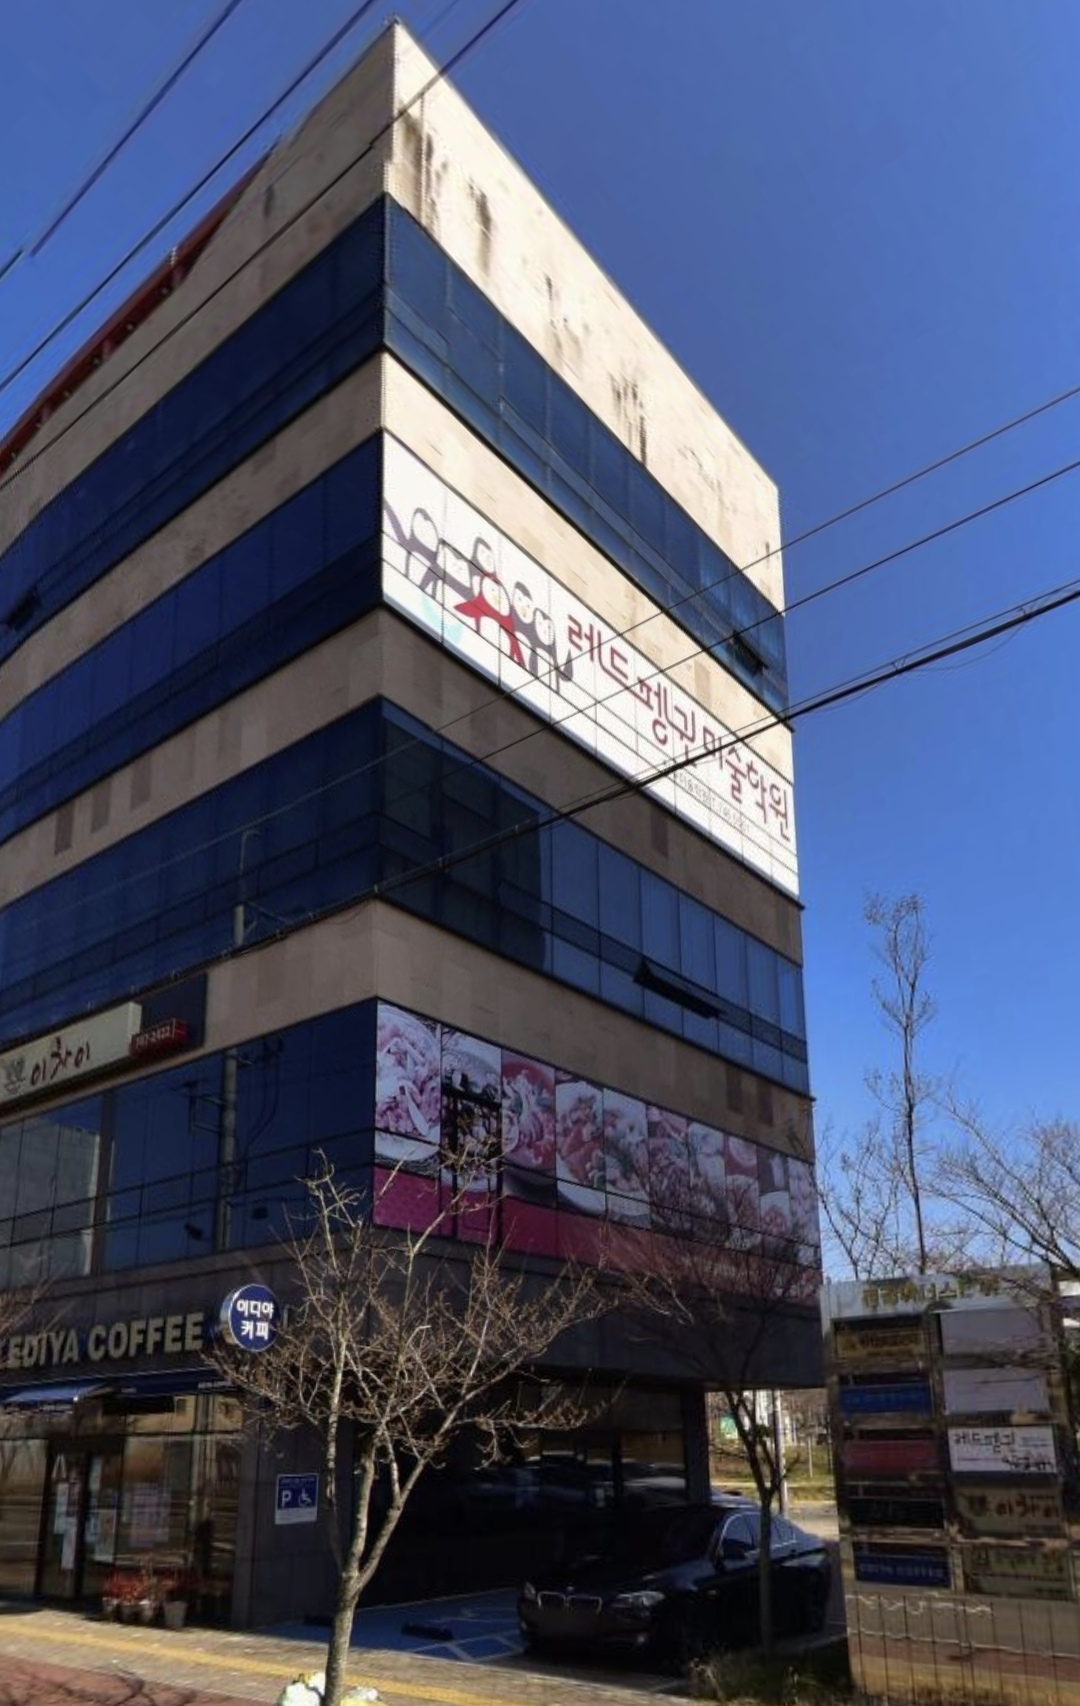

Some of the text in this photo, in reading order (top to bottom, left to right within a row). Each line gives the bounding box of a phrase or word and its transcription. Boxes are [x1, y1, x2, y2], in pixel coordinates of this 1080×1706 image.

[236, 1298, 274, 1319] 이디야
[6, 1312, 204, 1369] EDIYA COFFEE
[240, 1320, 269, 1341] 커피
